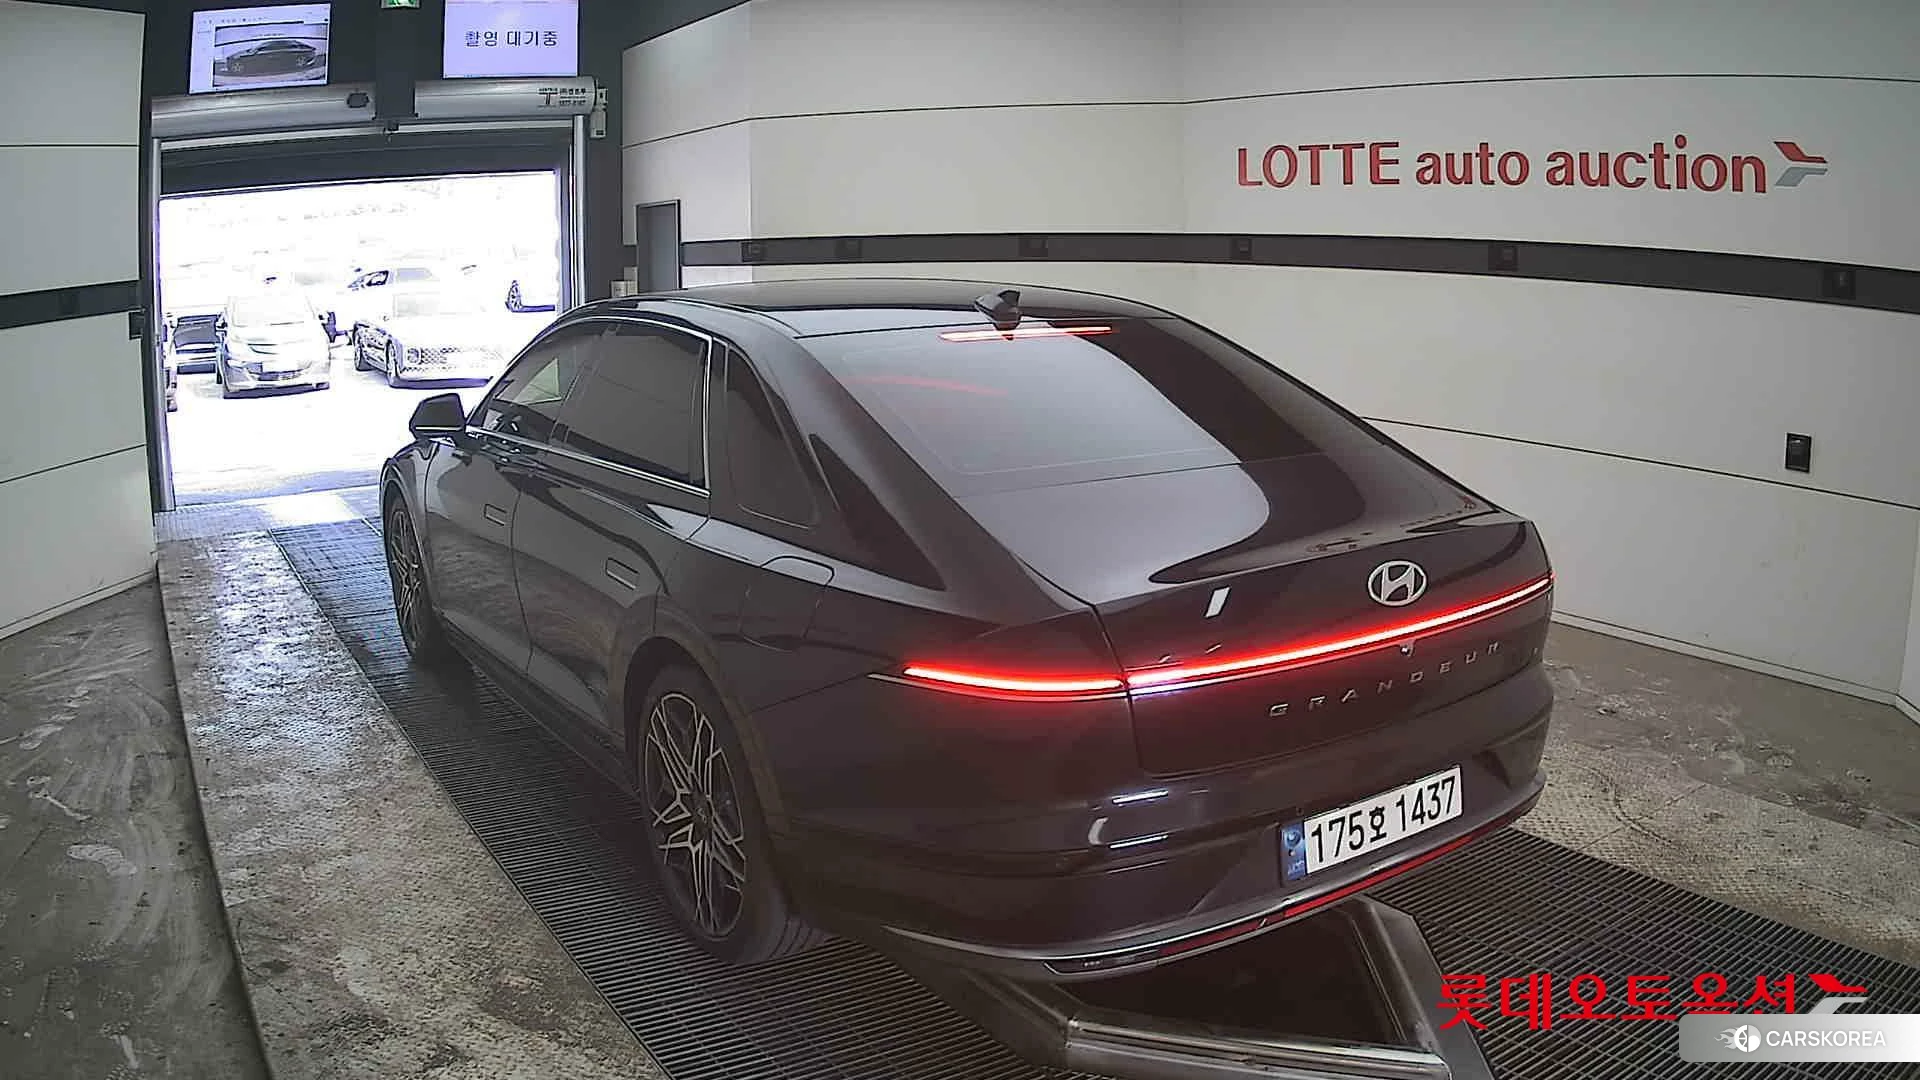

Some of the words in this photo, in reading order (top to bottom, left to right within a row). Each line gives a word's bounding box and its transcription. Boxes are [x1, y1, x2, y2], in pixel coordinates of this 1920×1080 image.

[507, 31, 558, 46] 대기중
[1238, 142, 1400, 187] LOTTE
[1416, 142, 1530, 186] auto
[1546, 135, 1767, 193] auction
[1269, 641, 1500, 717] GRANDEUR
[1311, 806, 1387, 863] 175호
[1396, 776, 1456, 832] 1437
